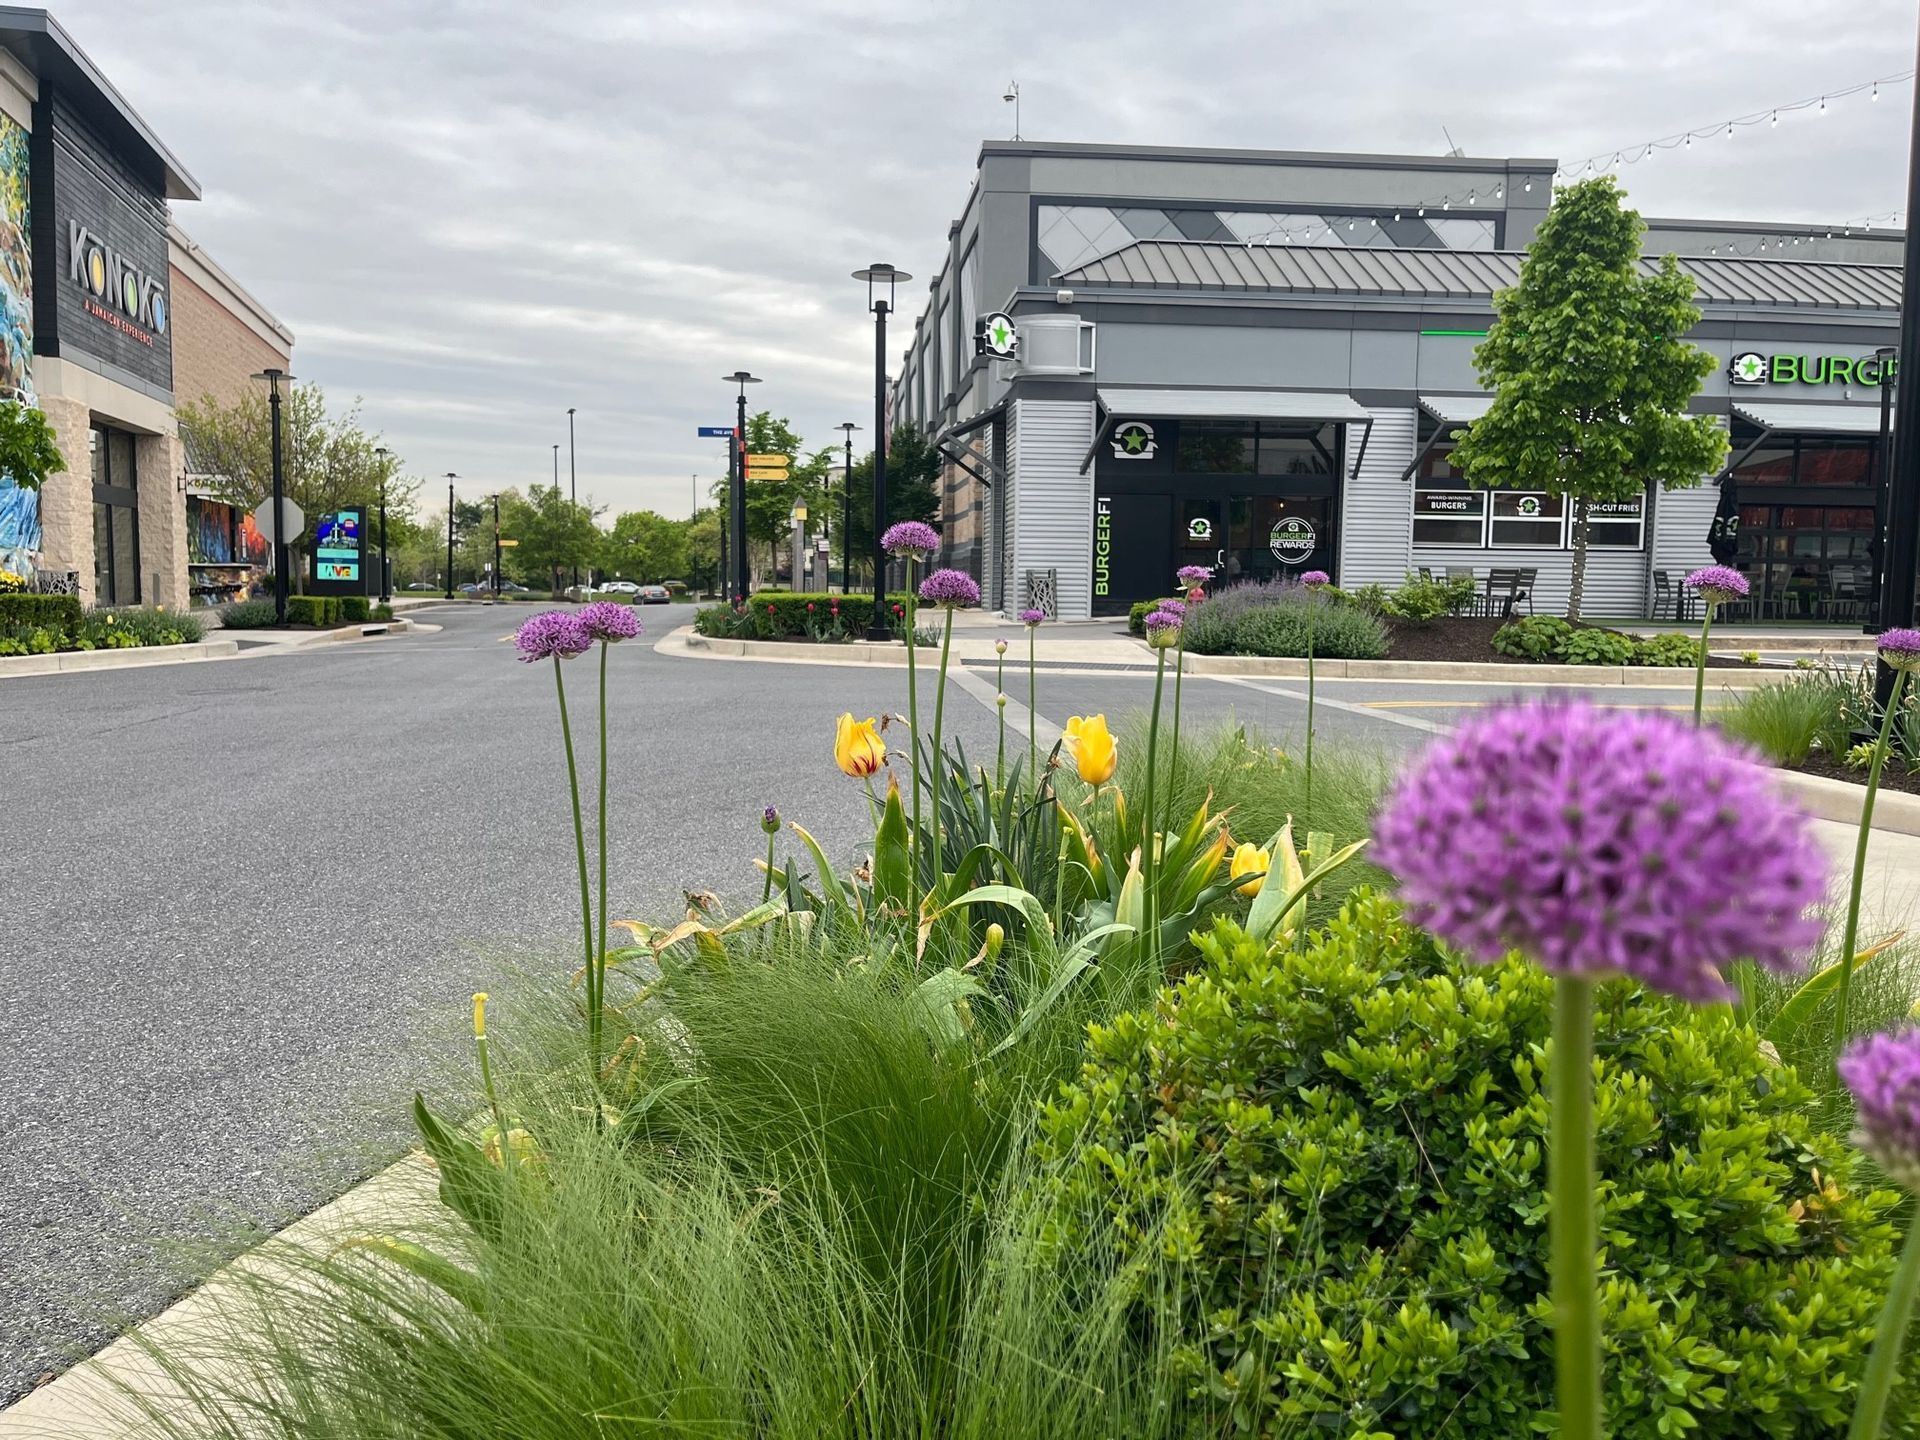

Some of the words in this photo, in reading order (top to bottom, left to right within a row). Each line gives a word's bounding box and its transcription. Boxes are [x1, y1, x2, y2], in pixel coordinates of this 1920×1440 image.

[84, 298, 90, 310] A
[92, 302, 121, 329] JAMAICAN
[122, 320, 154, 348] EXPERIENCE
[1431, 501, 1467, 510] BURGERS
[1618, 504, 1640, 513] FRIES
[1270, 532, 1316, 540] BURGERFI
[1095, 497, 1112, 596] BURGERFI
[1270, 541, 1315, 550] REWARDS
